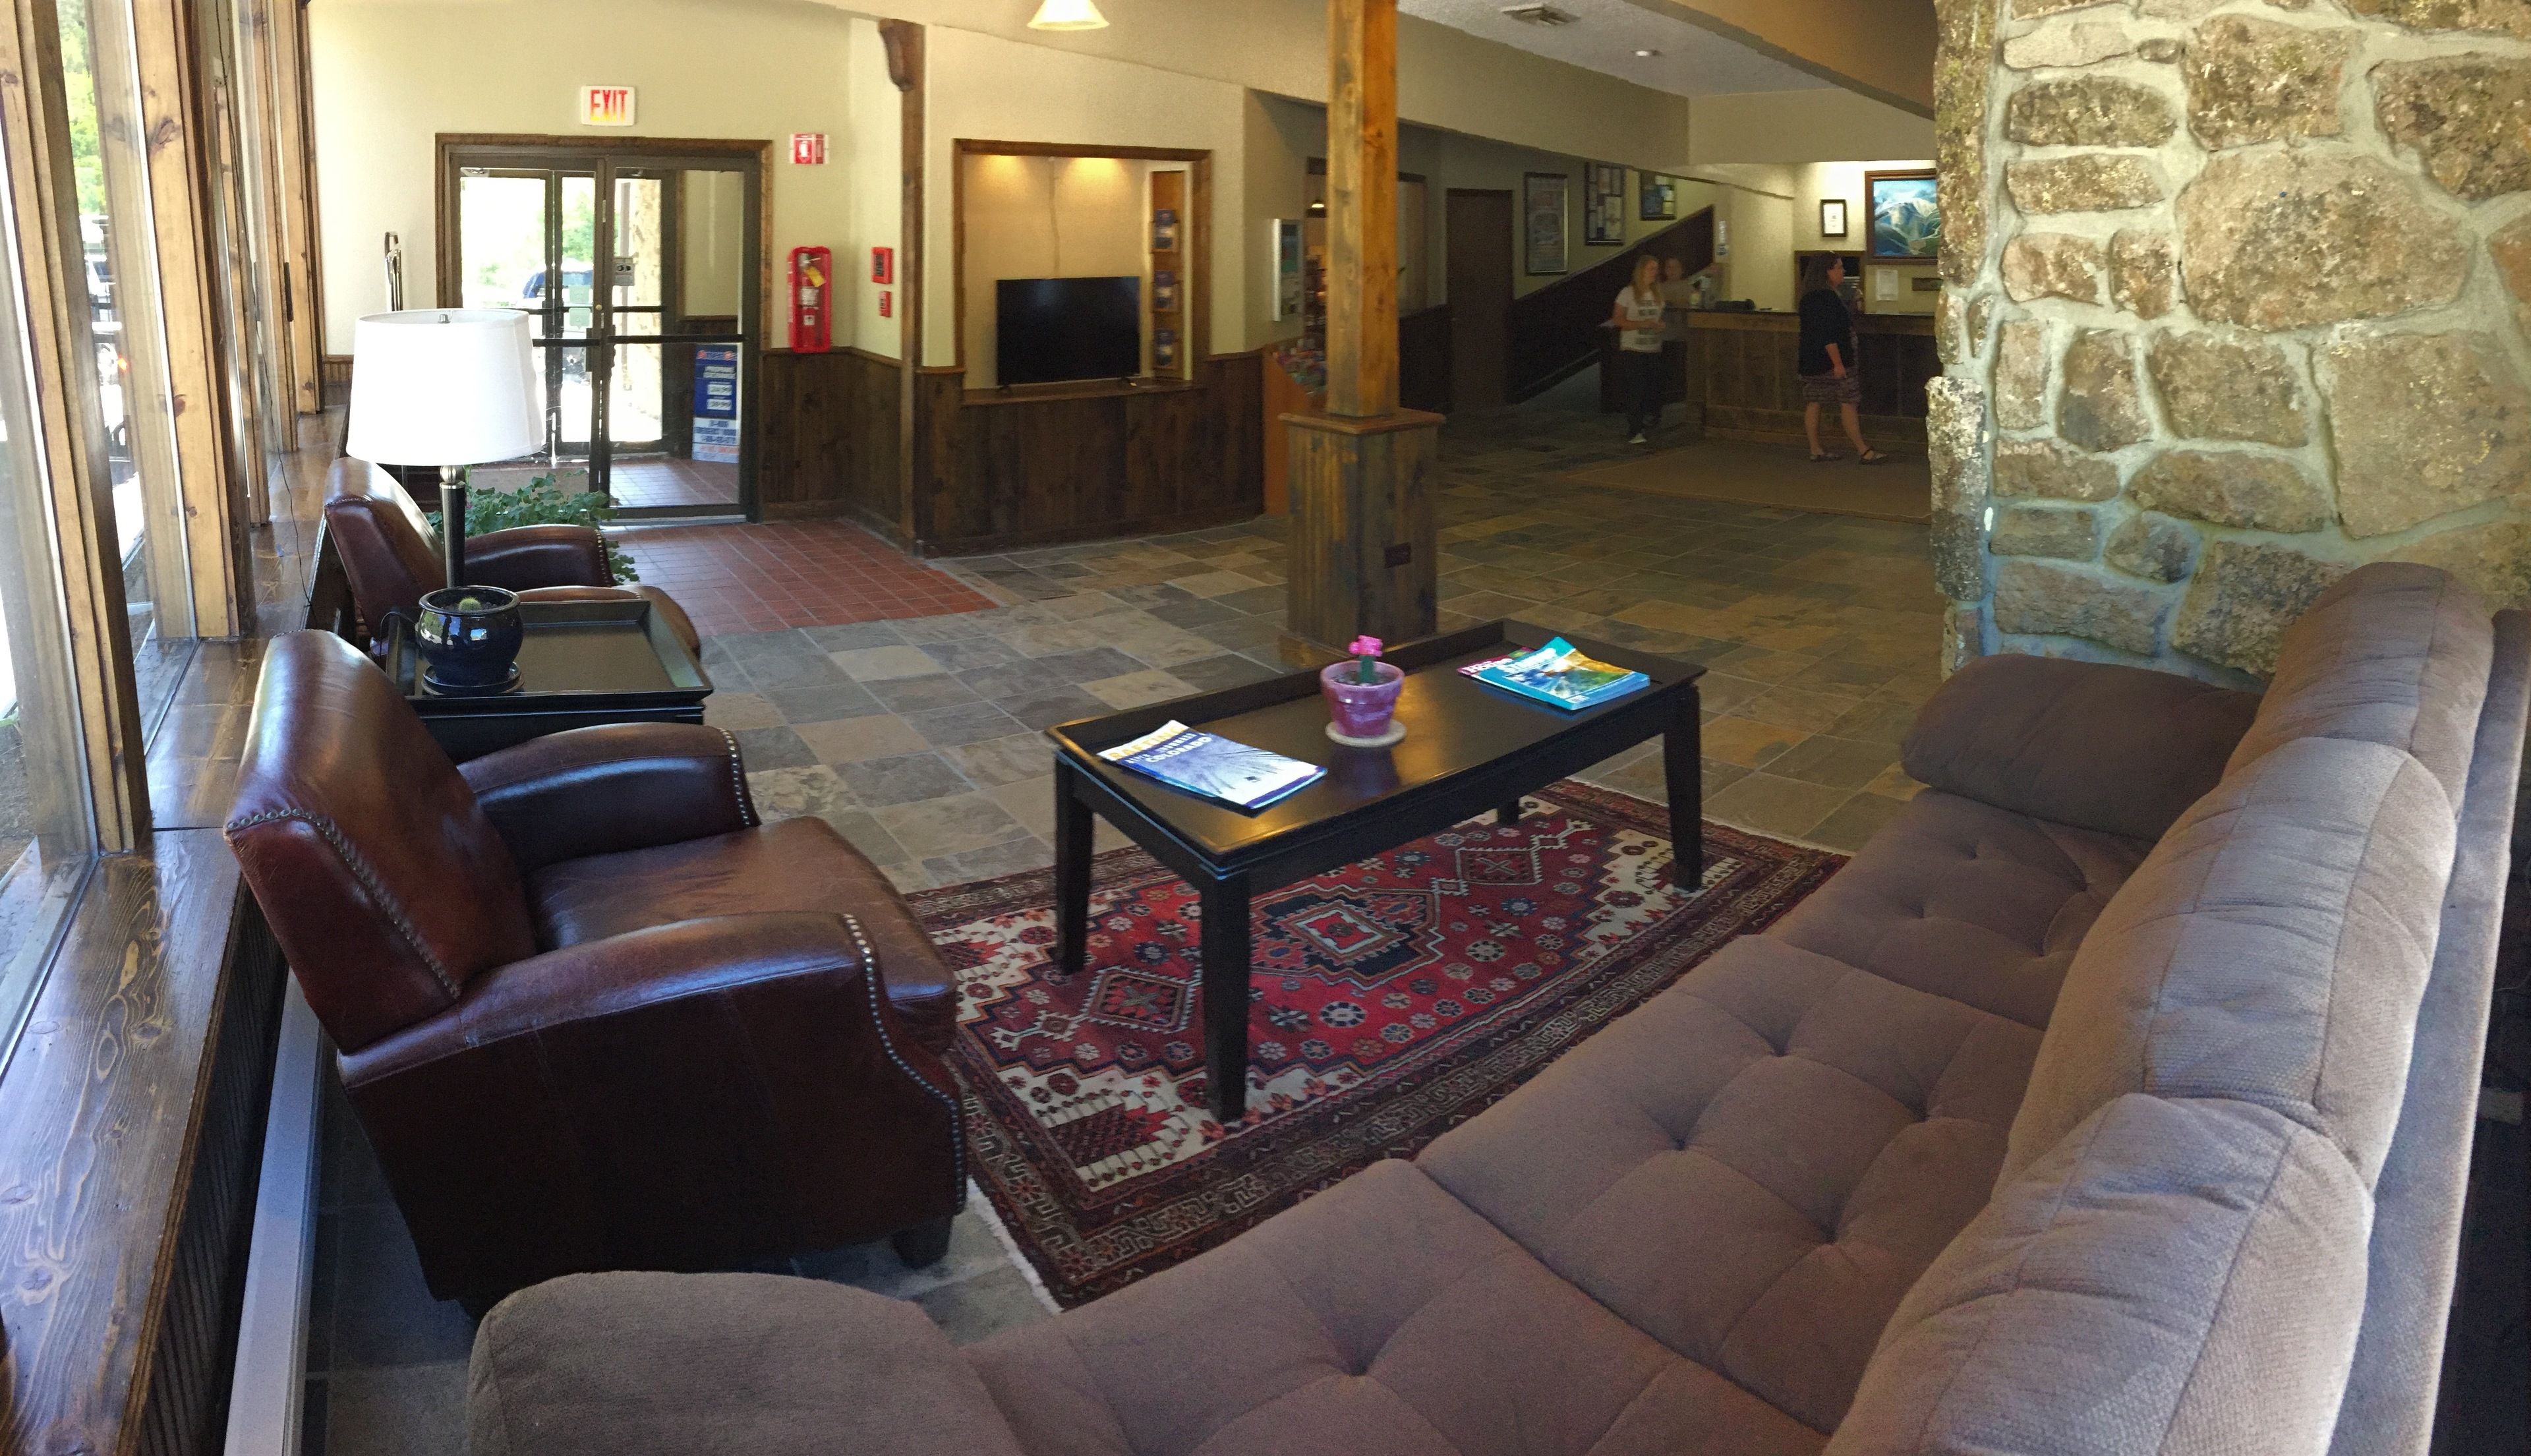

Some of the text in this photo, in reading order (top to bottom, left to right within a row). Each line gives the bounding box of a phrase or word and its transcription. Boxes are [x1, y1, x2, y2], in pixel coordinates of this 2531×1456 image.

[590, 90, 627, 121] EXIT
[1108, 726, 1186, 759] RAFTING
[1146, 736, 1213, 763] COLORADO
